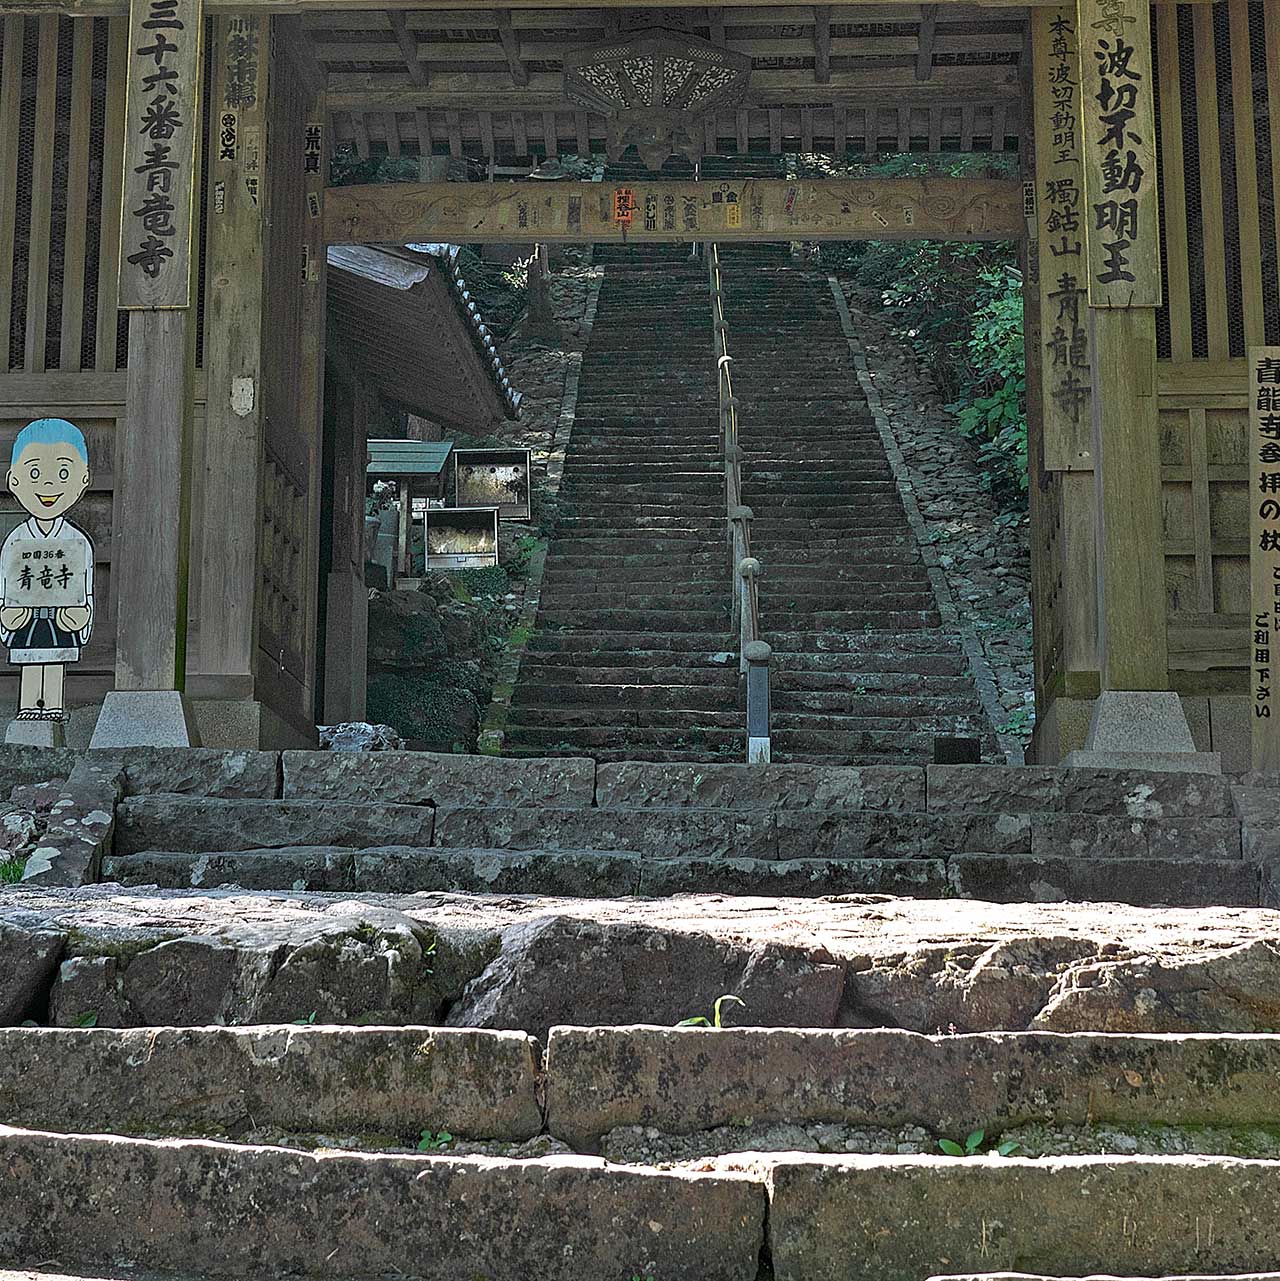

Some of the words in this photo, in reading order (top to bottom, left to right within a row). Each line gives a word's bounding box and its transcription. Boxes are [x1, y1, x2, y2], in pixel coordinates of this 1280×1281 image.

[1047, 15, 1080, 165] 本尊波切不動明王
[1045, 272, 1092, 423] 青龍寺
[16, 563, 75, 591] 青竜寺
[21, 549, 66, 561] 四国36番
[1254, 612, 1272, 719] ご利用下さい
